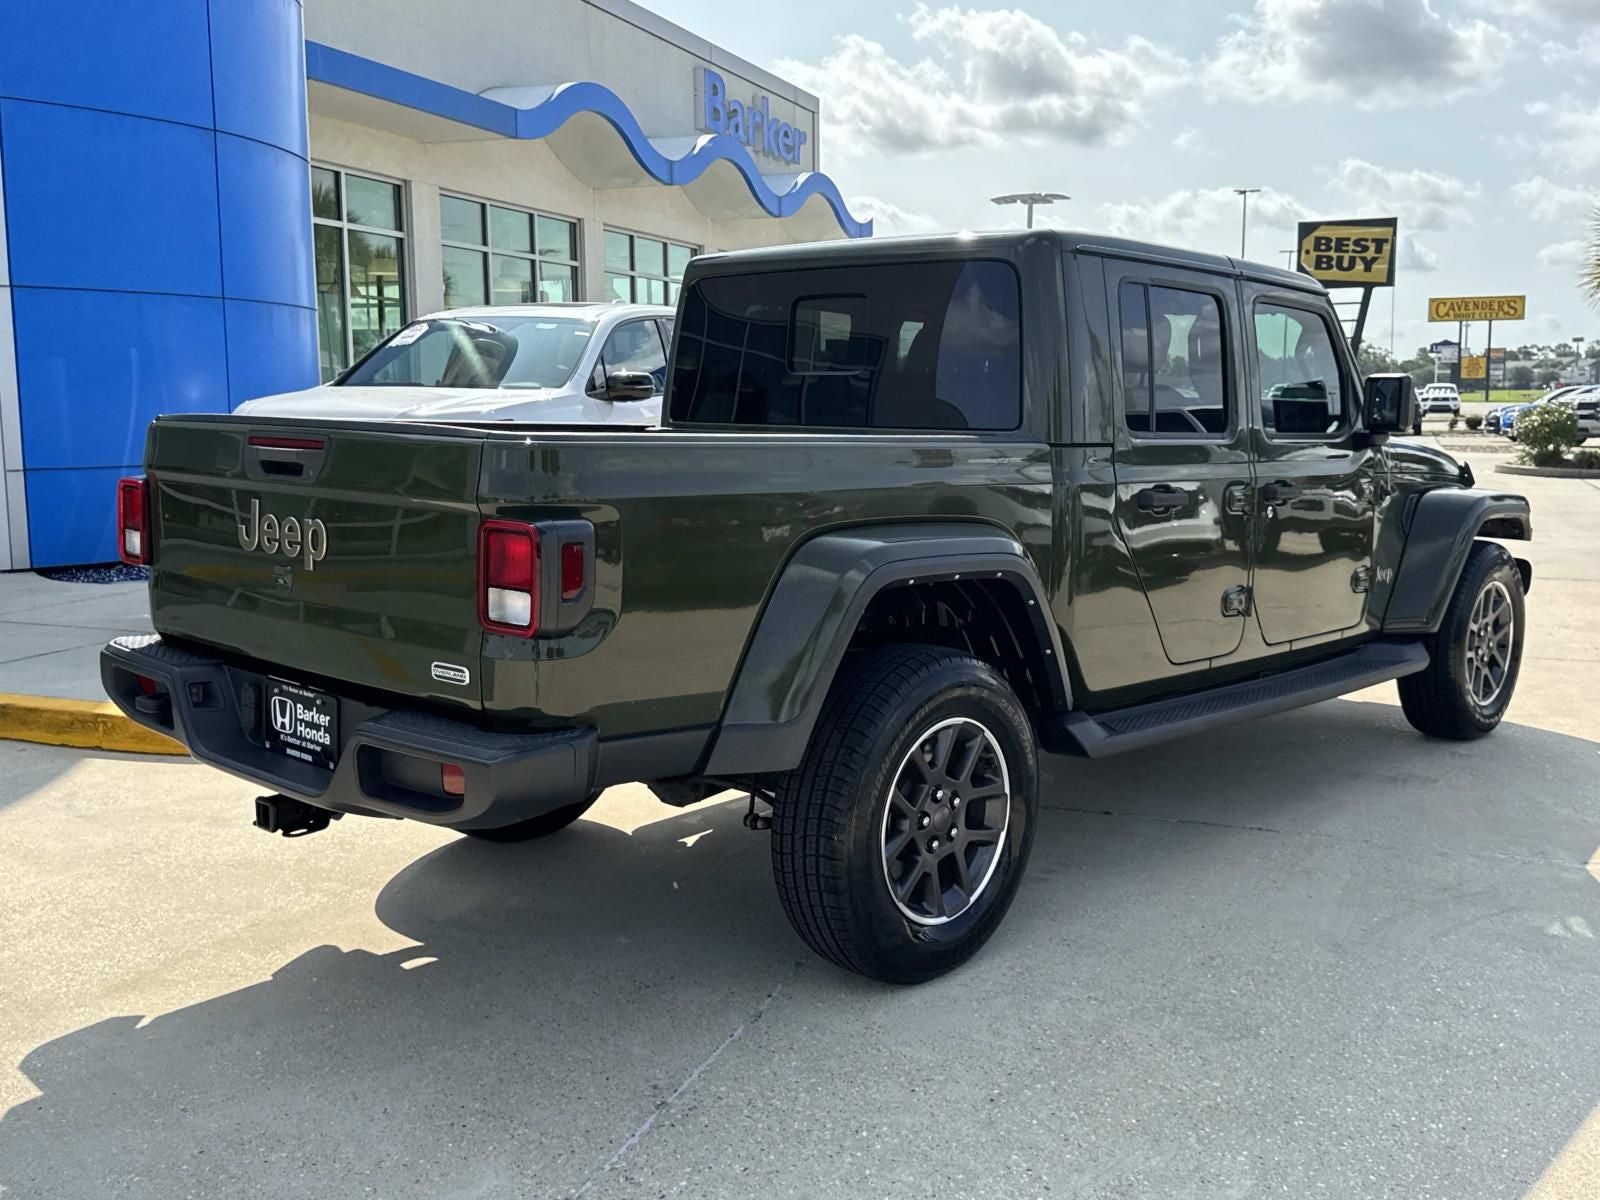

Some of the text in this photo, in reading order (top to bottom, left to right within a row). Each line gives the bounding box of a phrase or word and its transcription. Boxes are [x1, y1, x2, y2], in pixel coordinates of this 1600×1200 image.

[703, 68, 807, 165] Barker
[1313, 236, 1389, 255] BEST
[1314, 254, 1380, 272] BUY
[1435, 299, 1518, 318] CAVENDER'S
[238, 498, 327, 571] Jeep
[297, 703, 330, 727] Barker
[297, 721, 330, 745] Honda
